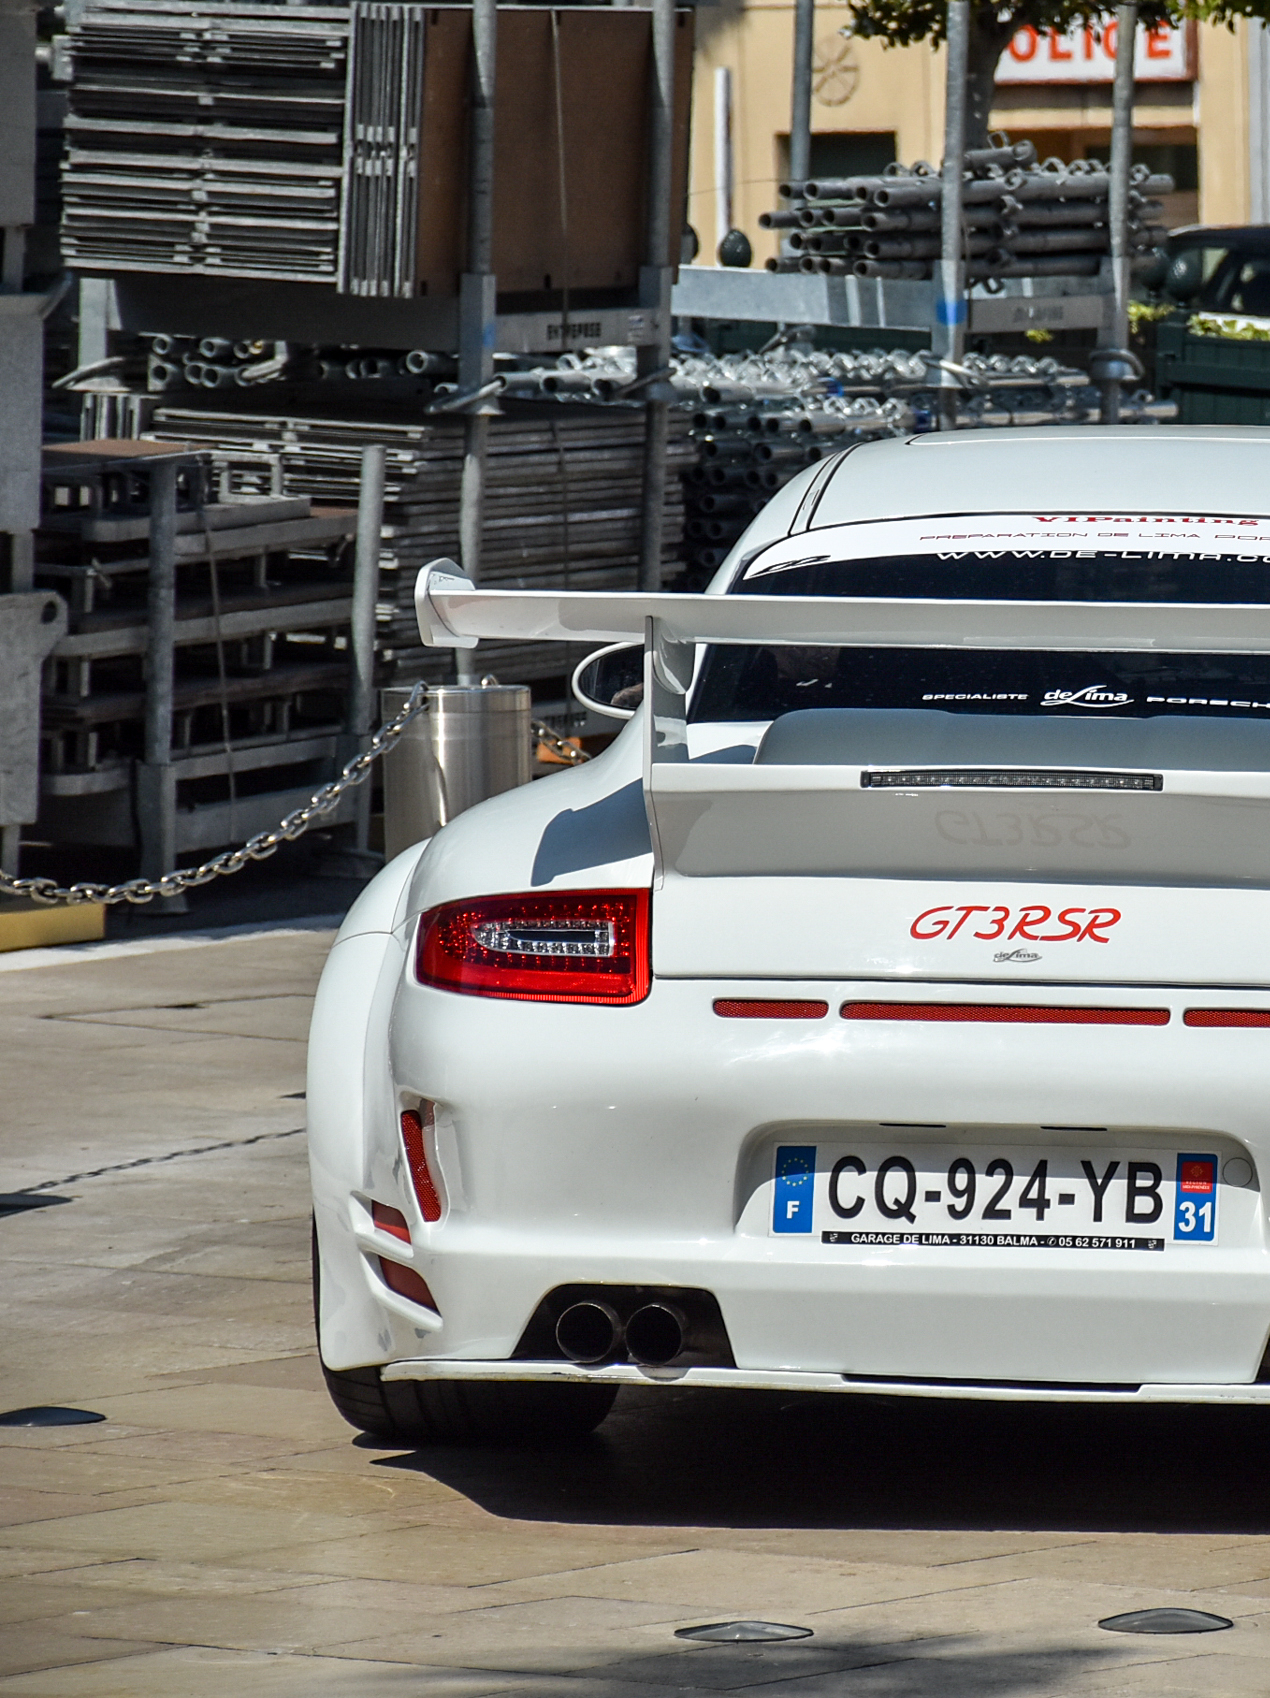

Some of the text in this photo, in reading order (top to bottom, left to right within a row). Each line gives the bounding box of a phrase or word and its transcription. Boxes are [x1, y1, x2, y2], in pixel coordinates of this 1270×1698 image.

[1033, 516, 1259, 526] VIPainting
[920, 532, 1088, 541] PREPARATION
[910, 905, 1121, 943] GT3RSR
[786, 1155, 1212, 1233] F CQ-924-YB 31
[851, 1233, 900, 1244] GARAGE
[903, 1234, 919, 1244] DE
[921, 1235, 950, 1244] LIMA
[959, 1235, 994, 1245] 31130
[997, 1236, 1038, 1245] BALMA
[1058, 1237, 1073, 1246] 05
[1075, 1237, 1089, 1247] 62
[1092, 1238, 1112, 1247] 571
[1115, 1238, 1136, 1248] 911
